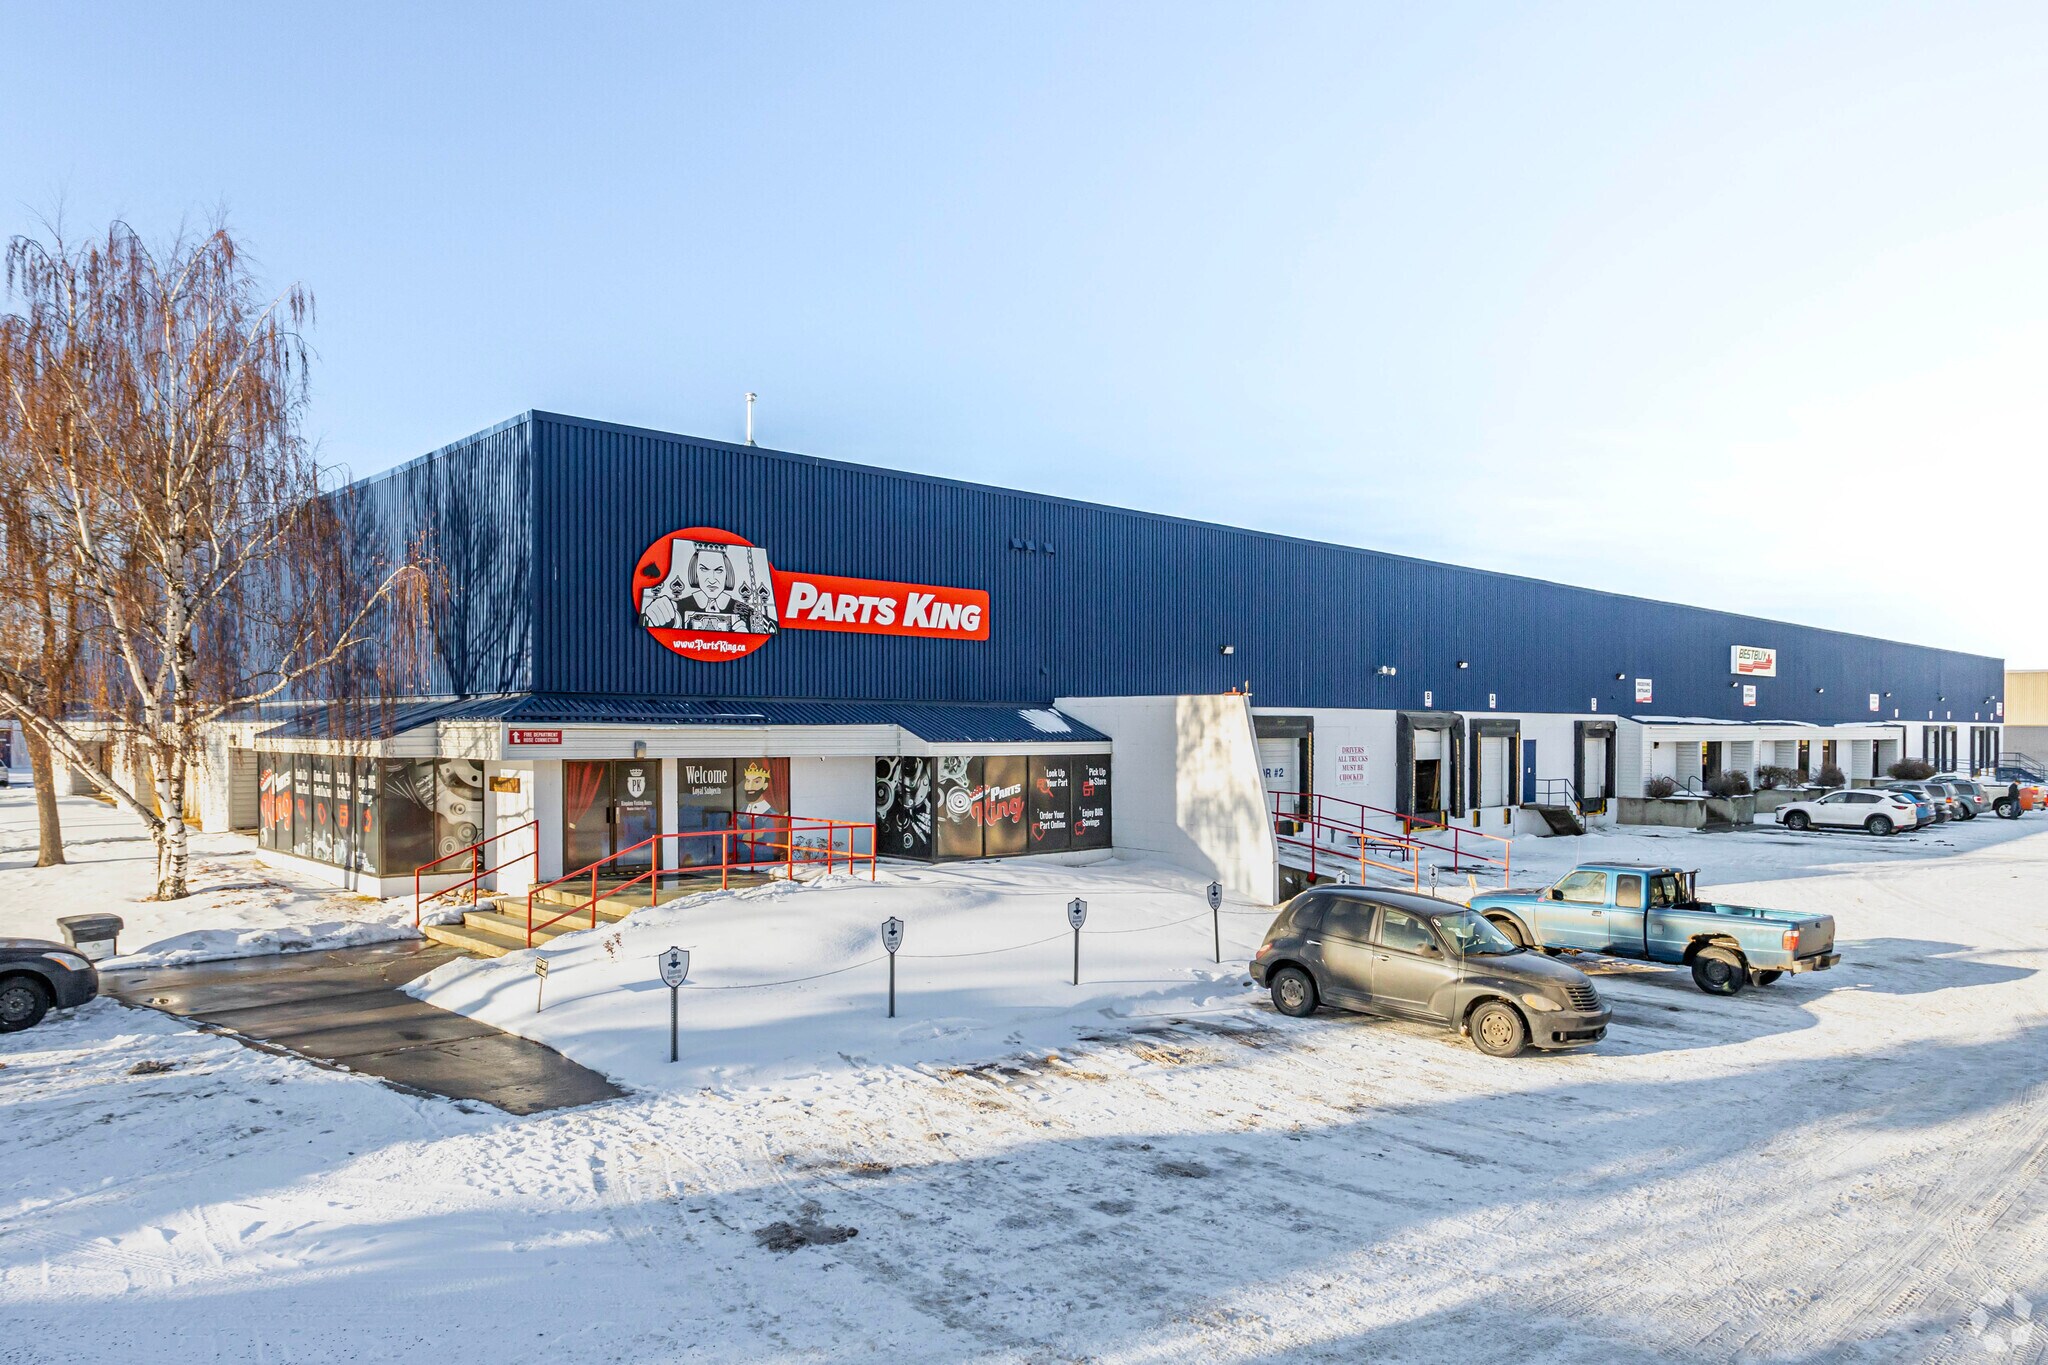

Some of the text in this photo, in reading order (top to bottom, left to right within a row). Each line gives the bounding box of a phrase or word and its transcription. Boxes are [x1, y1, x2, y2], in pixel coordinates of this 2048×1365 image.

[673, 639, 746, 653] www.PartsKing.ca
[1739, 649, 1767, 661] BESTBUY
[1342, 746, 1364, 754] DRIVERS
[686, 766, 728, 784] Welcome
[1046, 769, 1065, 778] Look Up
[1089, 768, 1106, 777] Pick Up
[1274, 767, 1284, 778] #2
[1339, 773, 1364, 781] CHOCKED
[632, 779, 641, 792] PK
[1046, 779, 1068, 787] Your Part
[692, 786, 722, 796] Loyal Subjects
[971, 796, 1025, 826] King
[1039, 810, 1065, 820] Order Your
[1082, 808, 1104, 818] Enjoy BIG
[1039, 820, 1066, 830] Part Online
[1082, 818, 1100, 828] Savings
